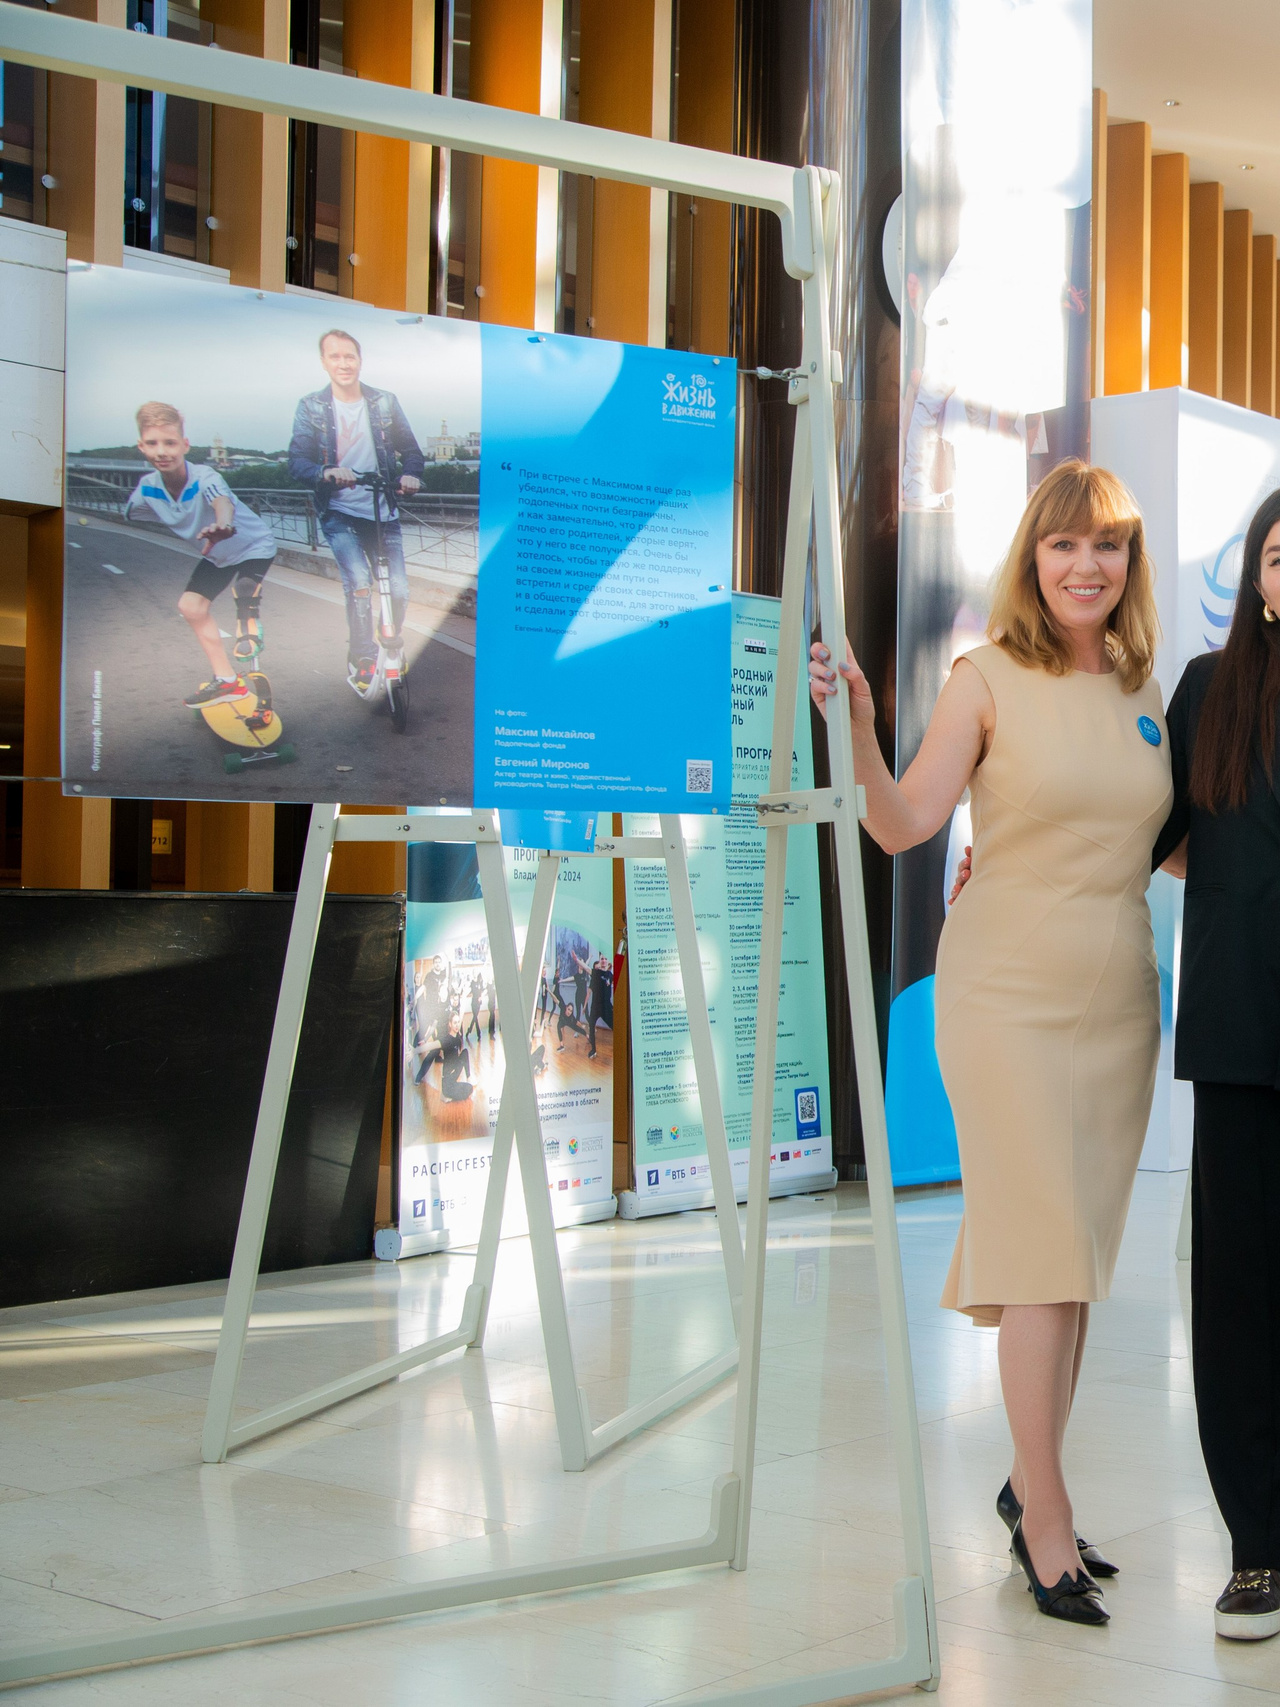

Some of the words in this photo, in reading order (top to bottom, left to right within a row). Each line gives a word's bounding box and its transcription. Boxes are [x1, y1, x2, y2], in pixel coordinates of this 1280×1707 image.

[661, 379, 716, 408] ЖИЗНЬ
[662, 402, 668, 414] В
[668, 404, 716, 419] ДВИЖЕНИИ
[519, 468, 539, 480] При
[542, 473, 580, 484] встрече
[592, 477, 643, 491] Максимом
[654, 486, 673, 495] еще
[675, 488, 691, 497] раз
[518, 482, 569, 497] убедился,
[571, 489, 587, 498] что
[590, 492, 655, 505] возможности
[658, 499, 688, 509] наших
[518, 497, 578, 510] подопечных
[581, 504, 609, 513] почти
[612, 505, 676, 521] безграничны,
[527, 512, 543, 520] как
[546, 514, 617, 528] замечательно,
[620, 522, 635, 530] что
[638, 523, 668, 533] рядом
[671, 527, 709, 537] сильное
[517, 524, 546, 533] плечо
[549, 527, 565, 536] его
[568, 529, 622, 542] родителей,
[626, 535, 665, 546] которые
[668, 539, 697, 550] верят,
[517, 538, 533, 546] что
[537, 540, 542, 549] у
[545, 541, 567, 549] него
[589, 545, 640, 556] получится.
[643, 548, 672, 560] Очень
[675, 551, 688, 561] бы
[516, 551, 565, 563] хотелось,
[567, 555, 597, 566] чтобы
[600, 559, 630, 569] такую
[632, 562, 646, 570] же
[648, 563, 702, 577] поддержку
[516, 565, 528, 573] на
[531, 566, 562, 576] своем
[564, 569, 620, 580] жизненном
[623, 574, 645, 584] пути
[515, 578, 561, 589] встретил
[572, 583, 602, 593] среди
[605, 586, 633, 595] своих
[636, 588, 698, 602] сверстников,
[525, 592, 530, 600] в
[533, 591, 581, 604] обществе
[592, 598, 626, 608] целом,
[629, 601, 647, 609] для
[649, 603, 675, 612] этого
[677, 605, 693, 613] мы
[524, 606, 565, 616] сделали
[592, 610, 653, 623] фотопроект.
[514, 624, 543, 632] Евгений
[545, 627, 577, 635] Миронов
[731, 668, 773, 682] РОДНЫЙ
[92, 700, 102, 726] Павел
[507, 709, 527, 717] фото:
[731, 699, 754, 711] НЫЙ
[495, 726, 538, 737] Максим
[541, 728, 595, 740] Михайлов
[91, 727, 103, 771] Фотограф:
[494, 739, 540, 748] Подопечный
[494, 756, 538, 767] Евгений
[541, 759, 589, 771] Миронов
[563, 870, 581, 881] 2024
[569, 1087, 602, 1097] мероприятия
[580, 1097, 599, 1106] области
[671, 1169, 686, 1180] ВТБ
